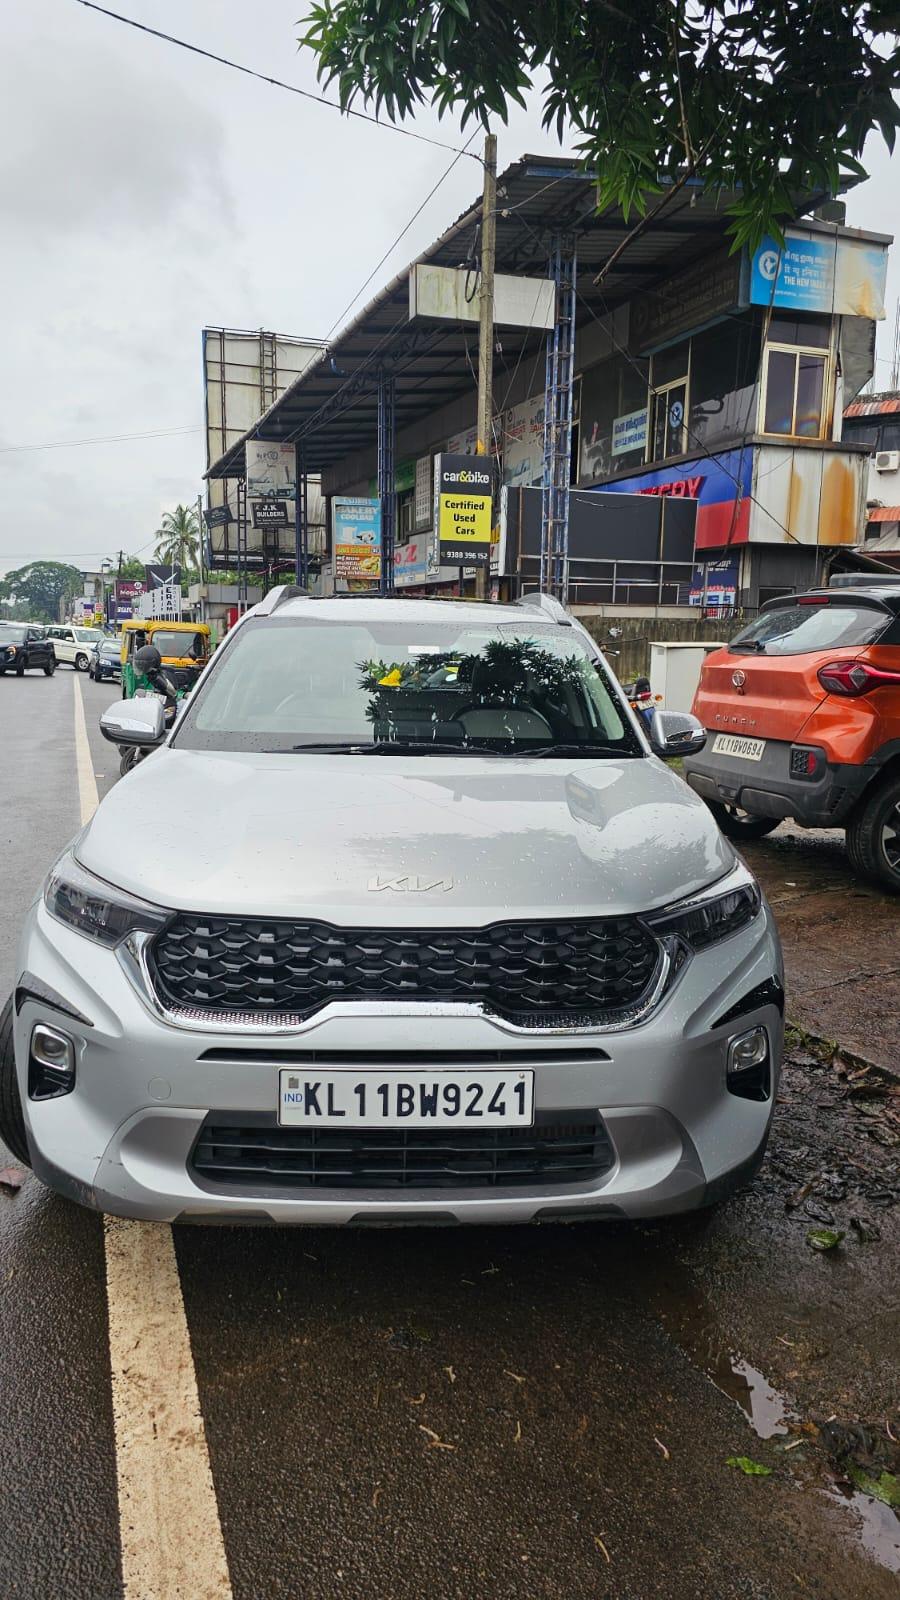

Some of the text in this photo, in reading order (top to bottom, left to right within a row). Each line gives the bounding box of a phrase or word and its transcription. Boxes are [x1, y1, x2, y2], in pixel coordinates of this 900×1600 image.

[783, 275, 796, 285] THE
[443, 470, 490, 484] car&bike
[445, 500, 485, 510] Certified
[453, 513, 476, 523] Used
[455, 526, 476, 536] Cars
[446, 551, 464, 559] 9388
[477, 552, 488, 560] 152
[715, 713, 757, 726] PUNCH
[716, 737, 762, 756] KL11BW0694
[284, 1082, 526, 1117] IND KL11BW9241
